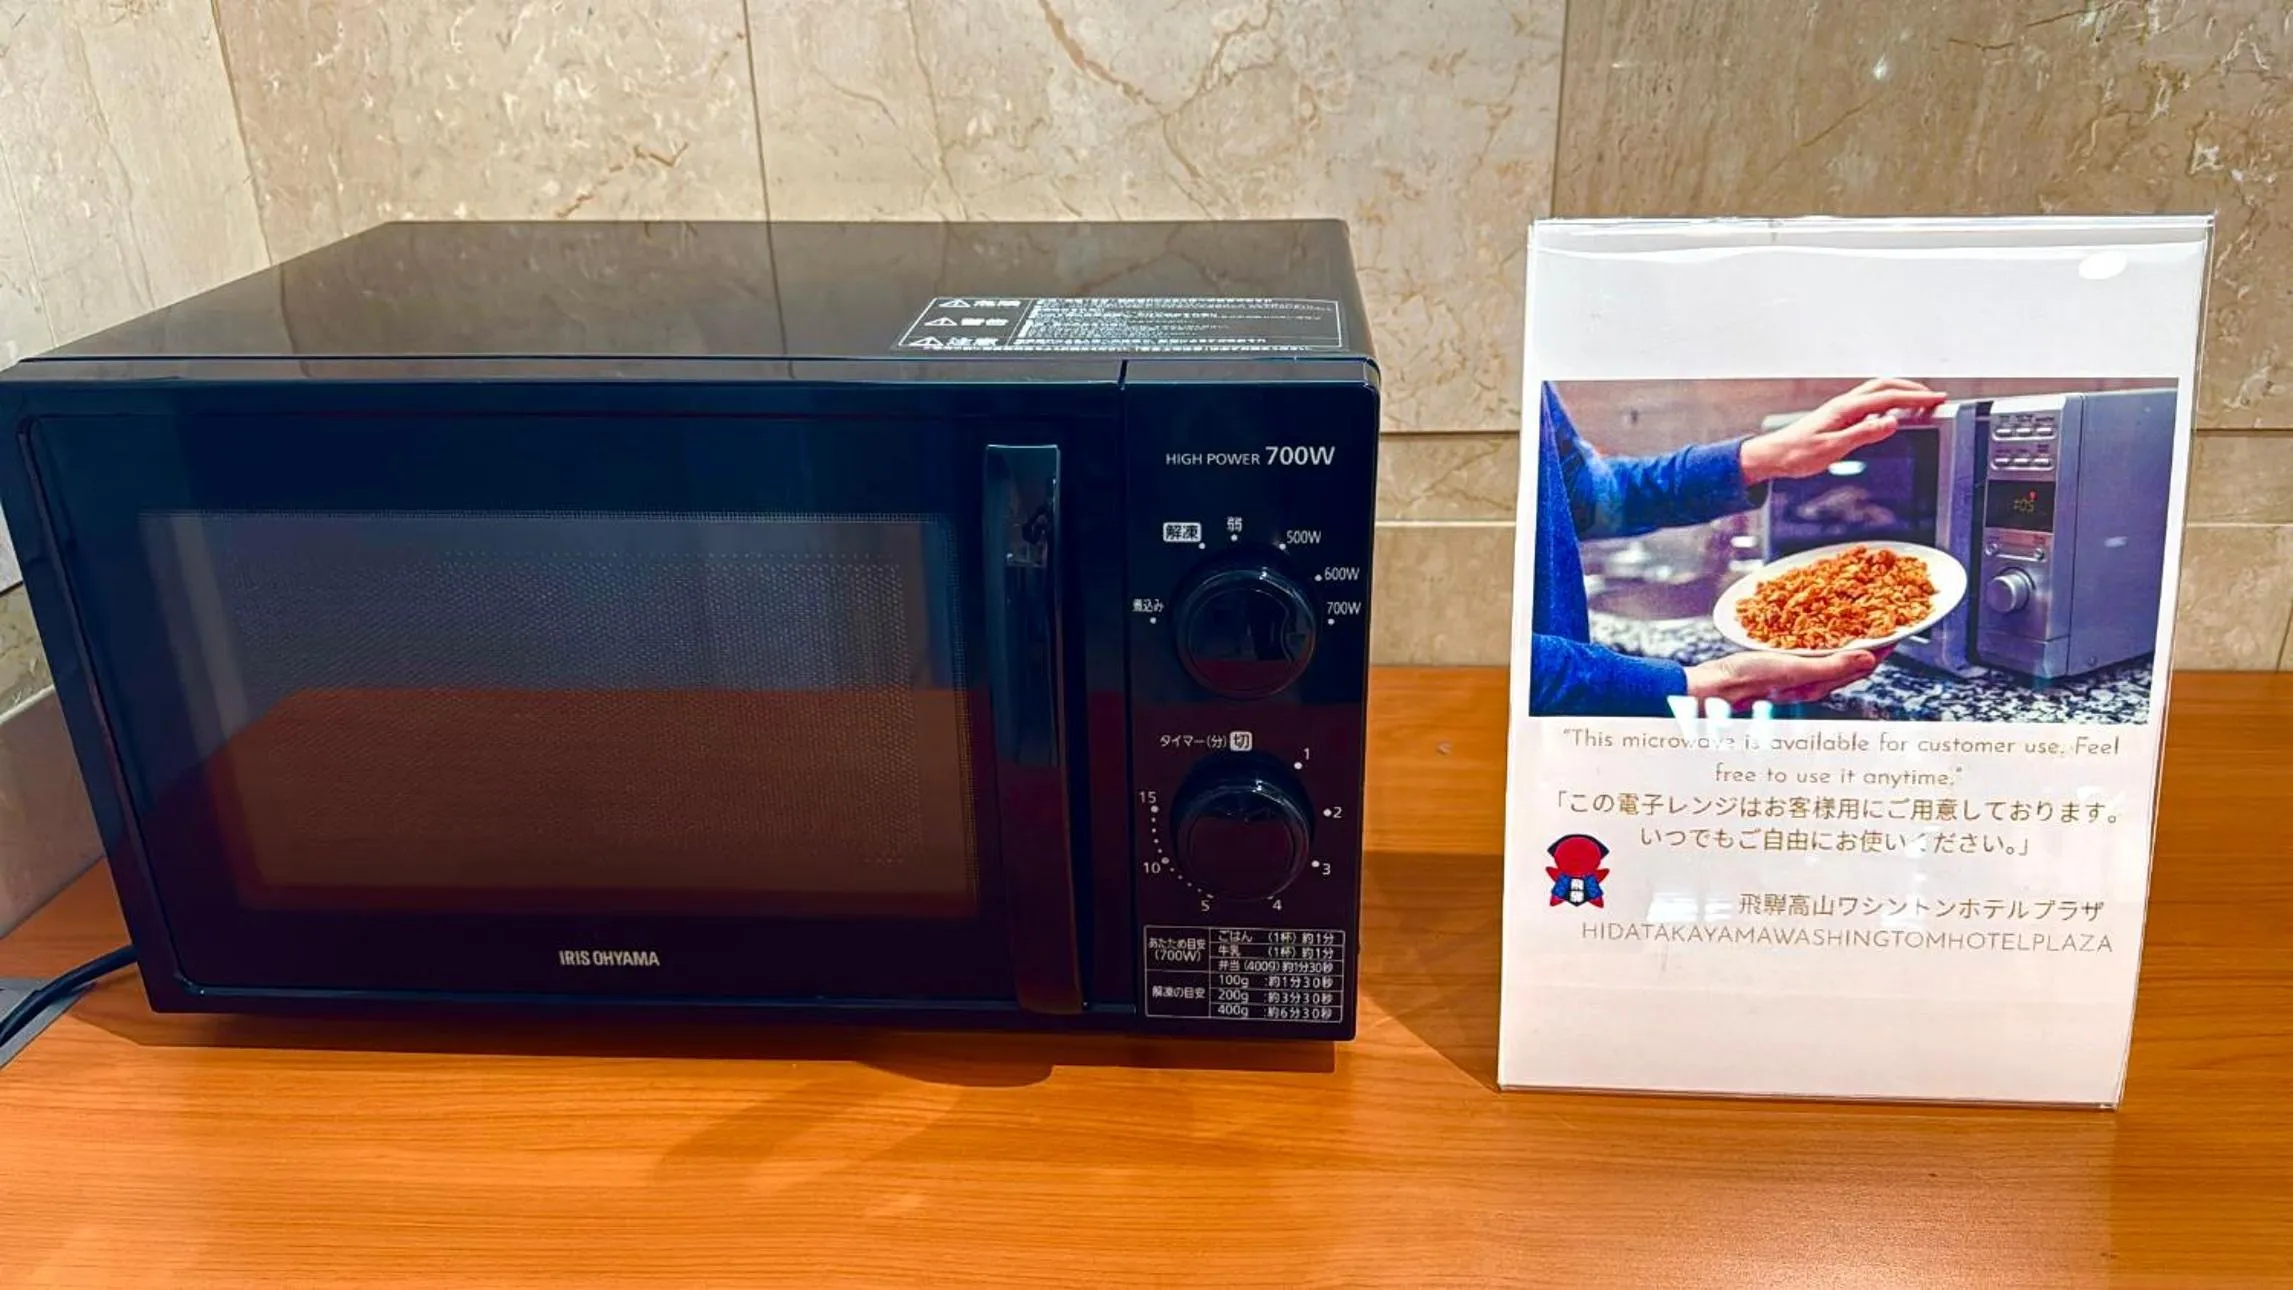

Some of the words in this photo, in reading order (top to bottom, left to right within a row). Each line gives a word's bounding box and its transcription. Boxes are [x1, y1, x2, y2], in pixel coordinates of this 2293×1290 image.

[1166, 453, 1202, 465] HIGH
[1207, 453, 1260, 465] POWER
[1265, 446, 1335, 465] 700W
[1226, 516, 1242, 532] 弱
[1164, 523, 1201, 541] 解凍
[1286, 530, 1322, 544] 500W
[1324, 567, 1360, 581] 600W
[1326, 601, 1361, 615] 700W
[1230, 731, 1252, 751] 切
[1622, 734, 1735, 750] microwae
[1771, 730, 1869, 751] available
[1879, 731, 1908, 751] for
[1918, 737, 2016, 753] customer
[2075, 736, 2119, 755] Feel
[1303, 748, 1310, 760] 1
[1715, 762, 1756, 782] free
[1767, 767, 1787, 783] to
[1797, 771, 1831, 784] use
[1840, 769, 1854, 784] it
[1139, 791, 1157, 804] 15
[1332, 806, 1342, 819] 2
[1144, 861, 1161, 874] 10
[1322, 863, 1331, 875] 3
[1201, 899, 1210, 911] 5
[1273, 899, 1282, 911] 4
[1218, 930, 1253, 943] ごはん
[1582, 922, 2113, 952] HIDATAKAYAMAWASHINGTOMHOTELPLAZA
[558, 950, 591, 966] IRIS
[592, 950, 660, 966] OHYAMA
[1219, 975, 1249, 988] 100g
[1218, 989, 1249, 1003] 200g
[1218, 1004, 1249, 1017] 400g
